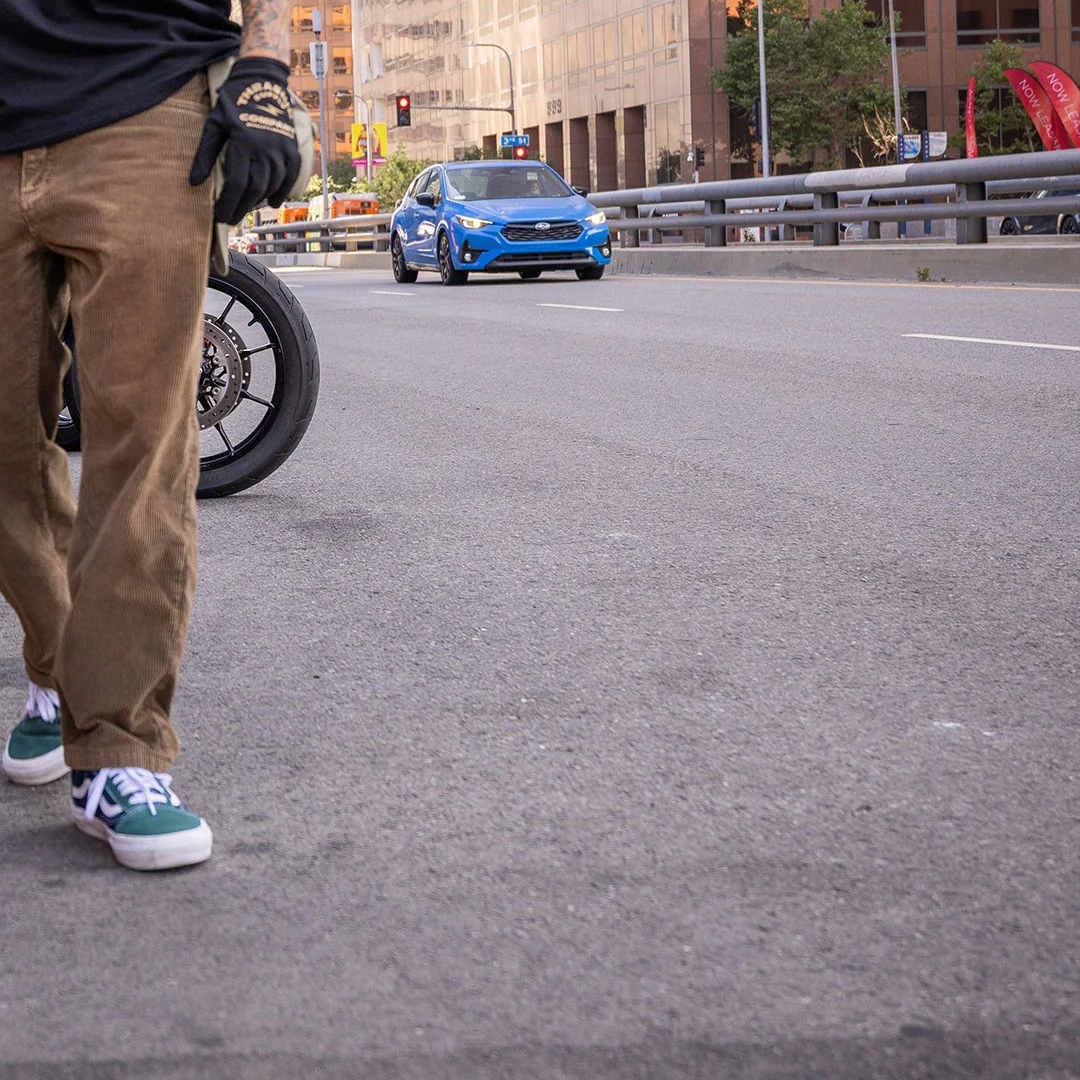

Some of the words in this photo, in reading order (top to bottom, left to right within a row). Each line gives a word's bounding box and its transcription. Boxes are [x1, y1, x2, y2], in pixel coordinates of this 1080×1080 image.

[1046, 72, 1071, 103] NOW
[1018, 78, 1041, 108] NOW
[1035, 108, 1061, 152] LEASIN
